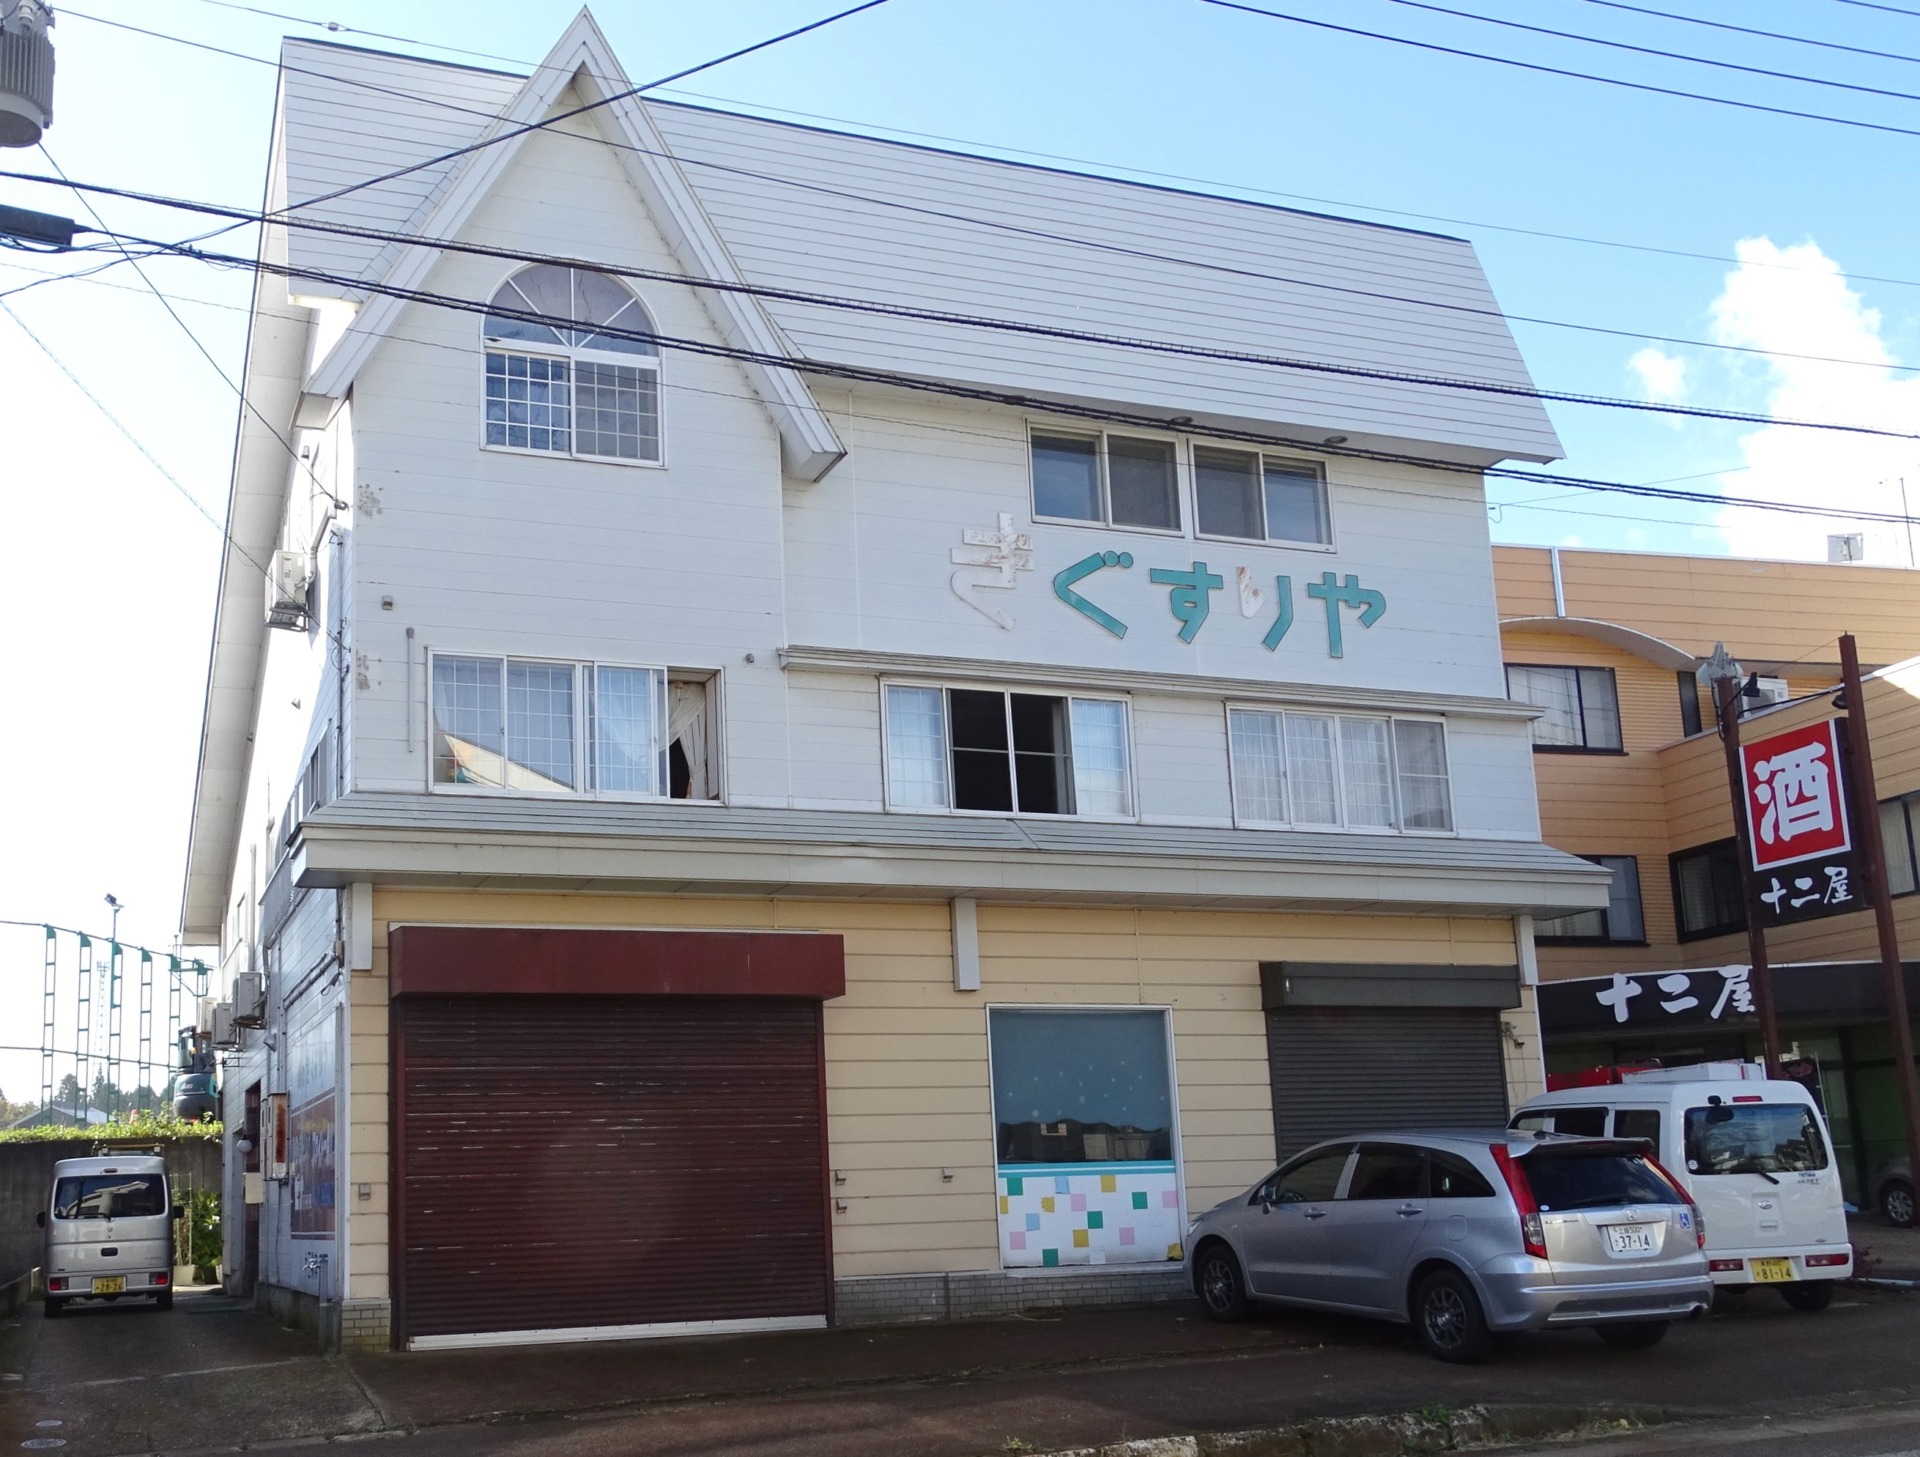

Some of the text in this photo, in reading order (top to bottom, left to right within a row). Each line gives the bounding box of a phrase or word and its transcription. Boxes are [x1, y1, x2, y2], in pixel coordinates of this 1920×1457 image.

[1753, 741, 1834, 845] 酒
[1760, 866, 1853, 914] 十二屋
[1596, 964, 1756, 1023] 十二屋
[1619, 1234, 1650, 1248] 37-14
[1761, 1267, 1792, 1280] 81-14
